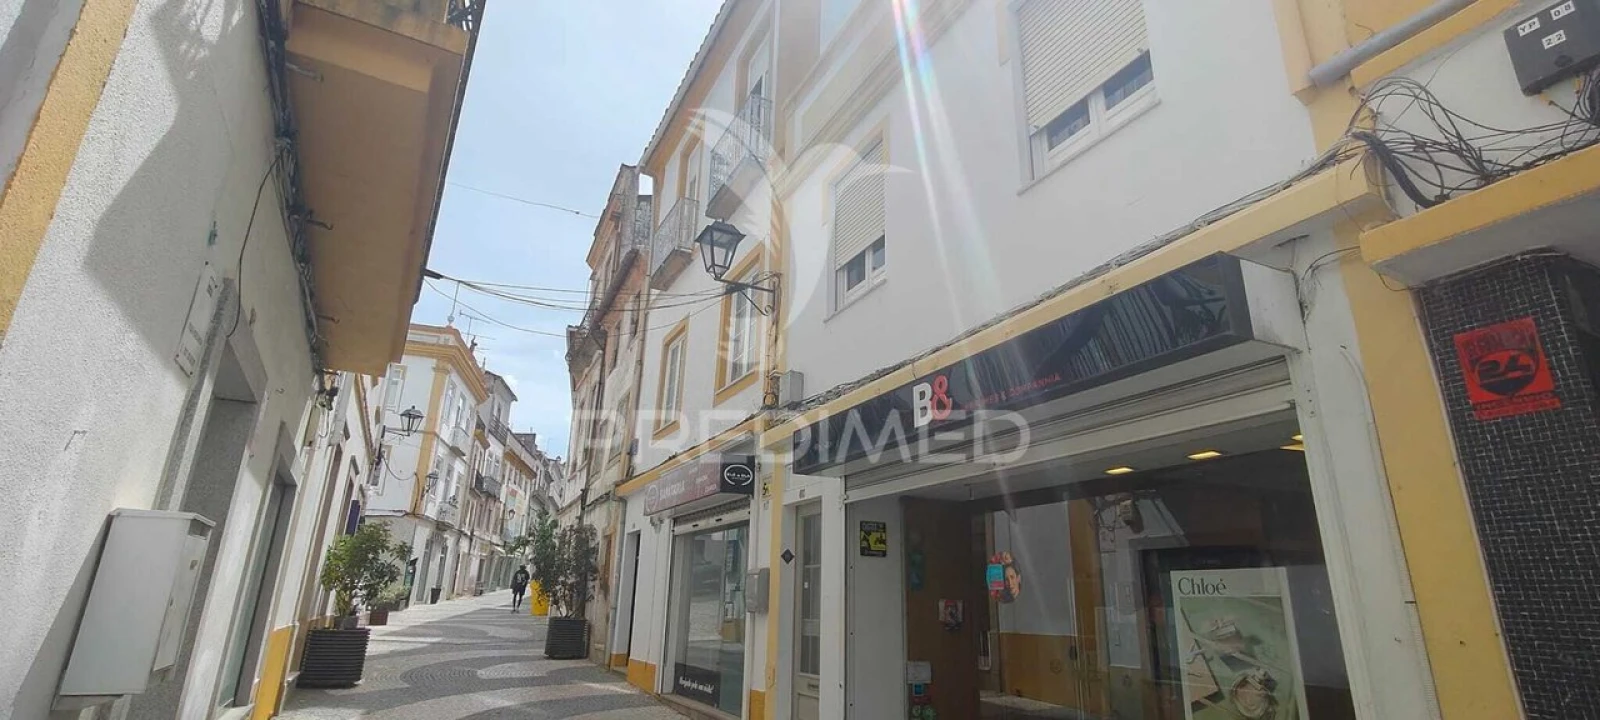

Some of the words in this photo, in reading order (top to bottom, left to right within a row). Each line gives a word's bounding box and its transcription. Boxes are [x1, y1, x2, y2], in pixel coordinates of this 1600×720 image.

[1519, 21, 1537, 33] YP
[1545, 33, 1562, 46] 22
[912, 374, 953, 428] B&
[1177, 576, 1227, 596] Chloé
